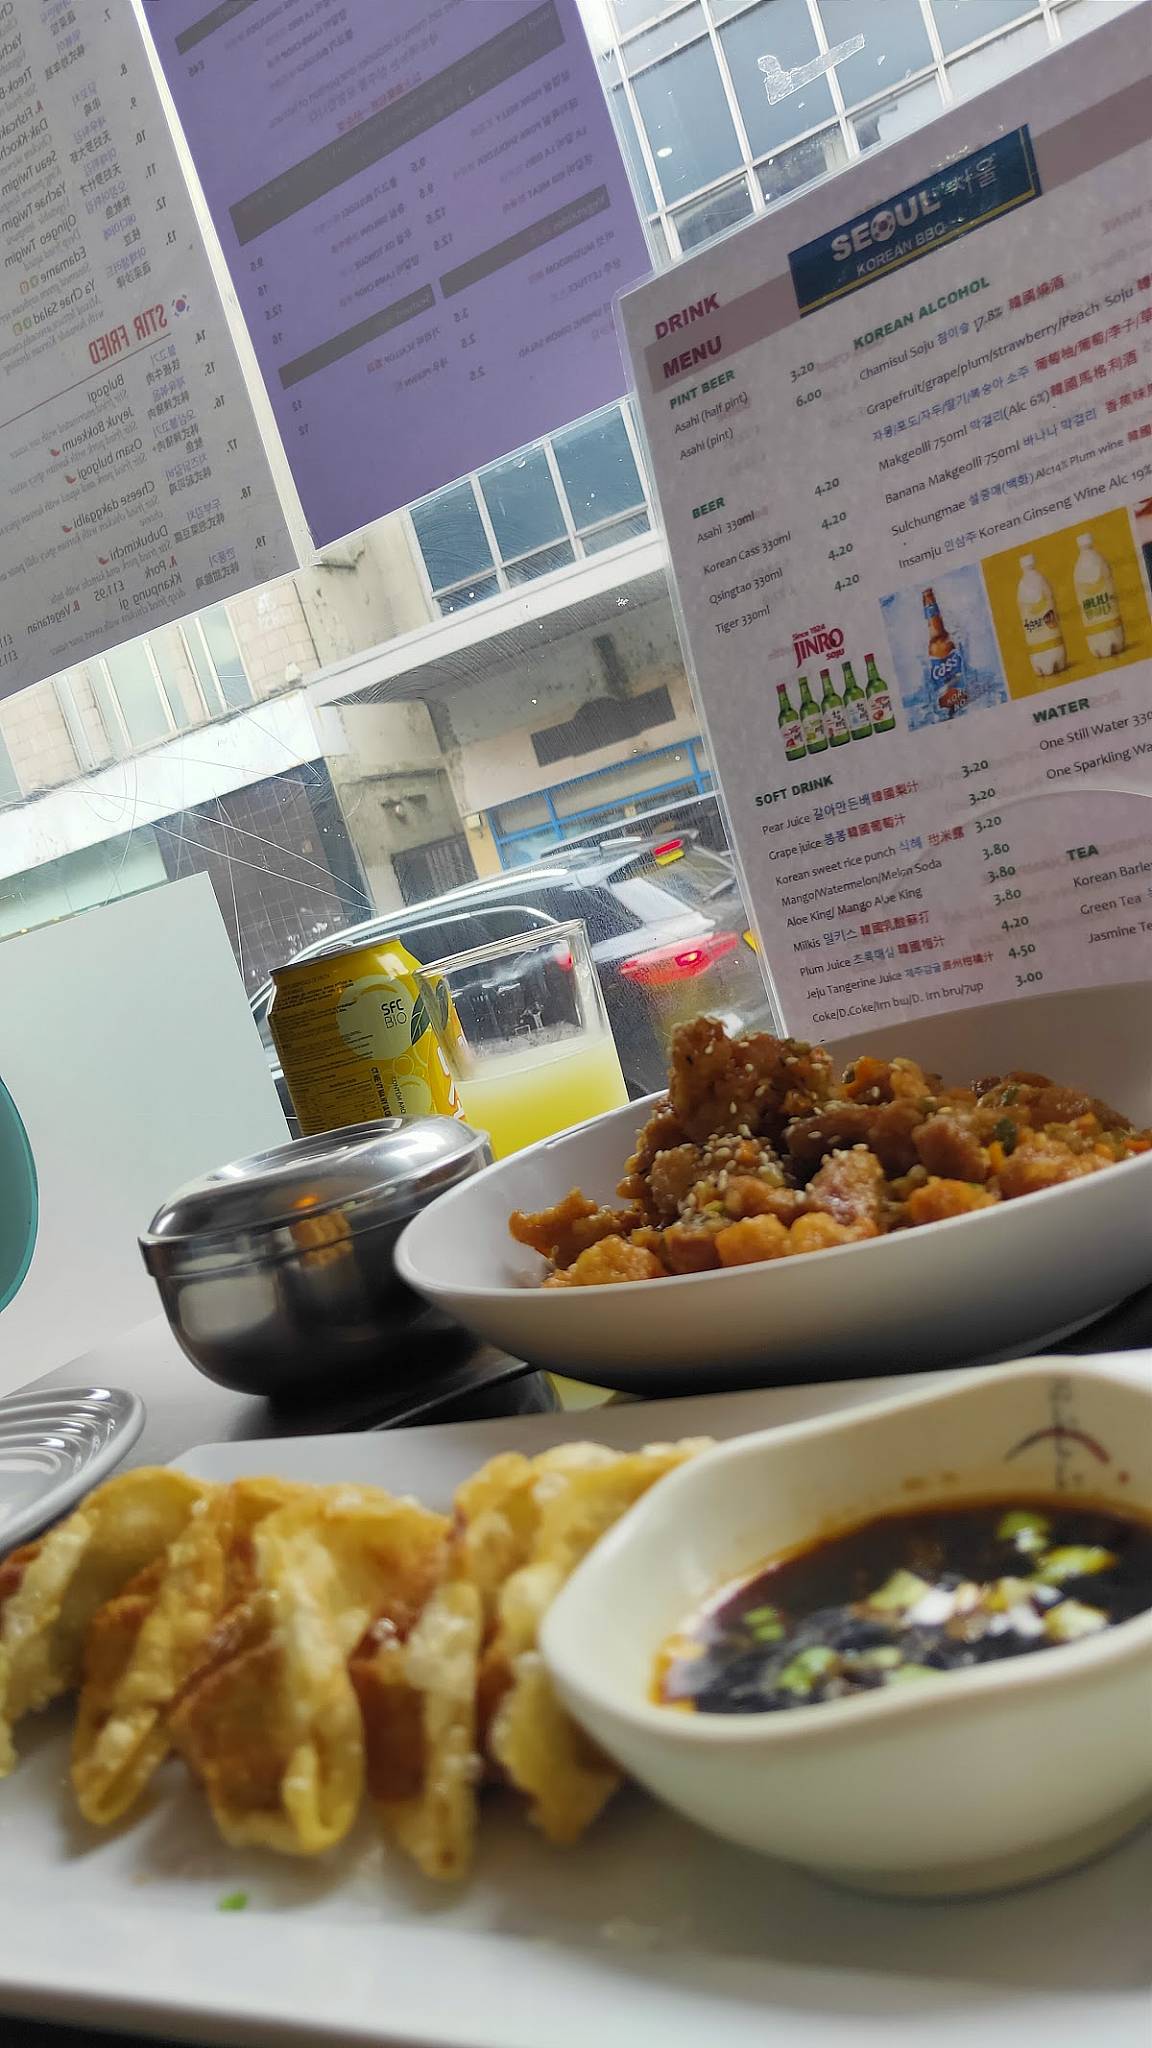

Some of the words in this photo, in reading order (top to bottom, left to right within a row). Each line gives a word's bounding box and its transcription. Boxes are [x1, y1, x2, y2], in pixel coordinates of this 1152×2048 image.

[831, 190, 941, 261] SEOUL
[855, 239, 913, 277] KOREAN
[914, 222, 946, 247] BBQ
[655, 292, 720, 340] DRINK
[853, 313, 914, 350] KOREAN
[919, 277, 990, 319] ALCOHOL
[662, 336, 722, 379] MENU
[859, 351, 907, 381] Chamisul
[909, 340, 935, 357] Soju
[866, 302, 1100, 416] Grapefruit/grape/plum/strawberry/Peach
[1105, 287, 1134, 308] Soju
[790, 362, 815, 383] 3.20
[669, 387, 698, 409] PINT
[701, 370, 736, 394] BEER
[796, 389, 822, 408] 6.00
[674, 415, 700, 434] Asahi
[701, 403, 723, 423] (half
[724, 392, 749, 412] pint)
[680, 441, 706, 460] Asahi
[706, 428, 734, 449] (pint)
[879, 441, 931, 472] Makgeolli
[933, 424, 968, 451] 750ml
[885, 481, 926, 504] Banana
[928, 456, 983, 487] Makgeolli
[984, 441, 1021, 466] 750ml
[1023, 424, 1058, 446] 바나나
[814, 478, 840, 496] 4.20
[891, 501, 967, 536] Sulchungmae
[1070, 450, 1096, 465] Plum
[1098, 440, 1124, 455] wine
[692, 497, 726, 519] BEER
[821, 512, 847, 530] 4.20
[899, 546, 942, 568] Insamju
[979, 516, 1021, 539] Korean
[1022, 497, 1073, 521] Ginseng
[1073, 484, 1106, 502] Wine
[1109, 474, 1129, 490] Alc
[697, 525, 722, 543] Asahi
[726, 511, 755, 534] 330ml
[703, 555, 737, 575] Korean
[738, 545, 760, 560] Cass
[761, 531, 792, 554] 330ml
[827, 543, 853, 561] 4.20
[709, 581, 752, 605] Qsingtao
[753, 567, 783, 590] 330ml
[834, 574, 860, 592] 4.20
[715, 619, 739, 634] Tiger
[741, 605, 770, 627] 330ml
[793, 628, 844, 668] JINRO
[1032, 698, 1091, 724] WATER
[1039, 736, 1065, 750] One
[1066, 728, 1090, 743] Still
[1090, 717, 1130, 735] Water
[961, 760, 989, 778] 3.20
[1046, 766, 1071, 779] One
[1073, 750, 1131, 773] Sparkling
[1132, 741, 1152, 756] Wa
[755, 789, 787, 807] SOFT
[791, 775, 834, 796] DRINK
[968, 788, 996, 806] 3.20
[762, 822, 784, 835] Pear
[785, 814, 810, 829] Juice
[975, 816, 1002, 833] 3.20
[768, 846, 802, 860] Grape
[800, 840, 822, 854] juice
[982, 843, 1010, 861] 3.80
[1065, 844, 1099, 861] TEA
[775, 870, 810, 886] Korean
[812, 861, 841, 876] sweet
[843, 855, 862, 867] rice
[864, 846, 896, 865] punch
[988, 866, 1017, 883] 3.80
[1073, 869, 1118, 888] Korean
[781, 867, 913, 907] Mango/Watermelon/Melon
[915, 859, 942, 872] Soda
[786, 916, 809, 928] Aloe
[809, 906, 835, 921] King/
[837, 900, 873, 916] Mango
[898, 887, 923, 901] King
[993, 888, 1022, 906] 3.80
[1080, 899, 1117, 916] Green
[1119, 893, 1142, 908] Tea
[1001, 916, 1029, 932] 4.20
[1087, 925, 1137, 944] Jasmine
[1138, 921, 1152, 934] Te
[793, 938, 821, 952] Milkis
[1008, 943, 1036, 959] 4.50
[800, 965, 825, 977] Plum
[826, 958, 851, 971] Juice
[1016, 970, 1043, 987] 3.00
[806, 986, 826, 999] Jeju
[828, 978, 877, 994] Tangerine
[878, 972, 902, 983] Juice
[381, 998, 404, 1016] SFC
[384, 1011, 407, 1029] BIO
